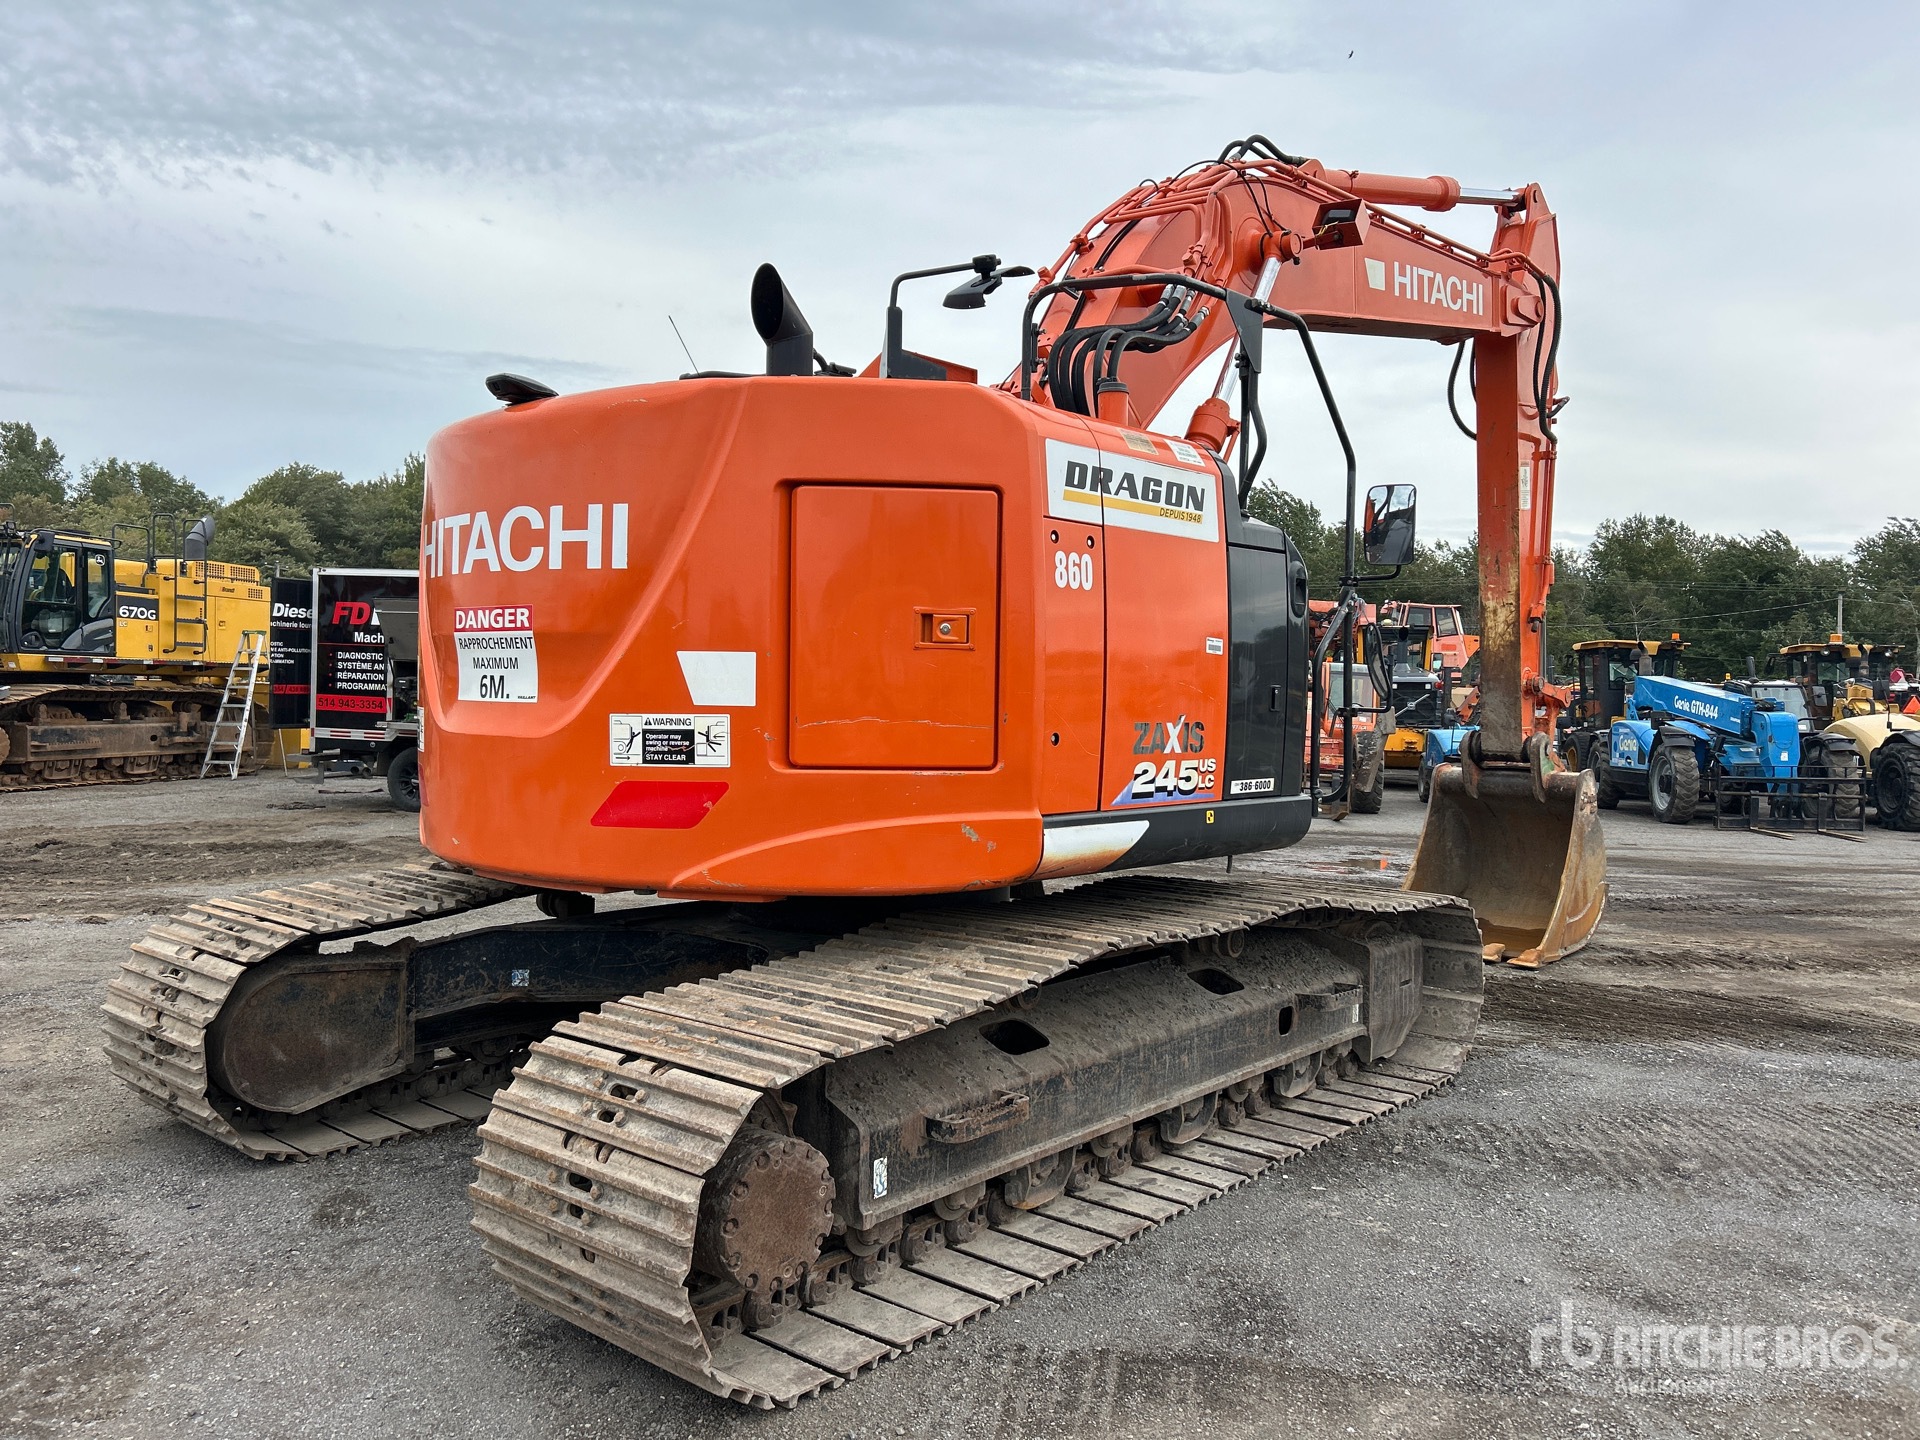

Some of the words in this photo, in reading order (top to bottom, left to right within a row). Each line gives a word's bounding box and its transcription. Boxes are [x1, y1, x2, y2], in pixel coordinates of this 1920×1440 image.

[1394, 261, 1483, 316] HITACHI
[1065, 460, 1206, 512] DRAGON
[1159, 506, 1186, 521] DEPUIS
[1185, 512, 1202, 524] 1948
[424, 503, 629, 579] HITACHI
[1055, 550, 1093, 591] 860
[119, 605, 157, 620] 670G
[455, 608, 530, 629] DANGER
[458, 636, 533, 650] RAPPROCHEMENT
[337, 651, 384, 661] DIAGNOSTIC
[472, 657, 519, 669] MAXIMUM
[337, 660, 373, 671] SYSTÈME
[337, 670, 384, 681] RÉPARATION
[480, 674, 510, 699] 6M.
[318, 698, 335, 707] 514
[338, 699, 383, 709] 943-3354
[1674, 695, 1691, 712] Genie
[1690, 700, 1719, 719] GTH-844
[652, 717, 692, 726] WARNING
[1132, 714, 1205, 754] ZAXIS
[1620, 735, 1637, 751] Genie
[1131, 760, 1199, 799] 245
[1199, 758, 1216, 773] US
[1197, 774, 1215, 789] LC
[1240, 780, 1271, 791] 386-6000
